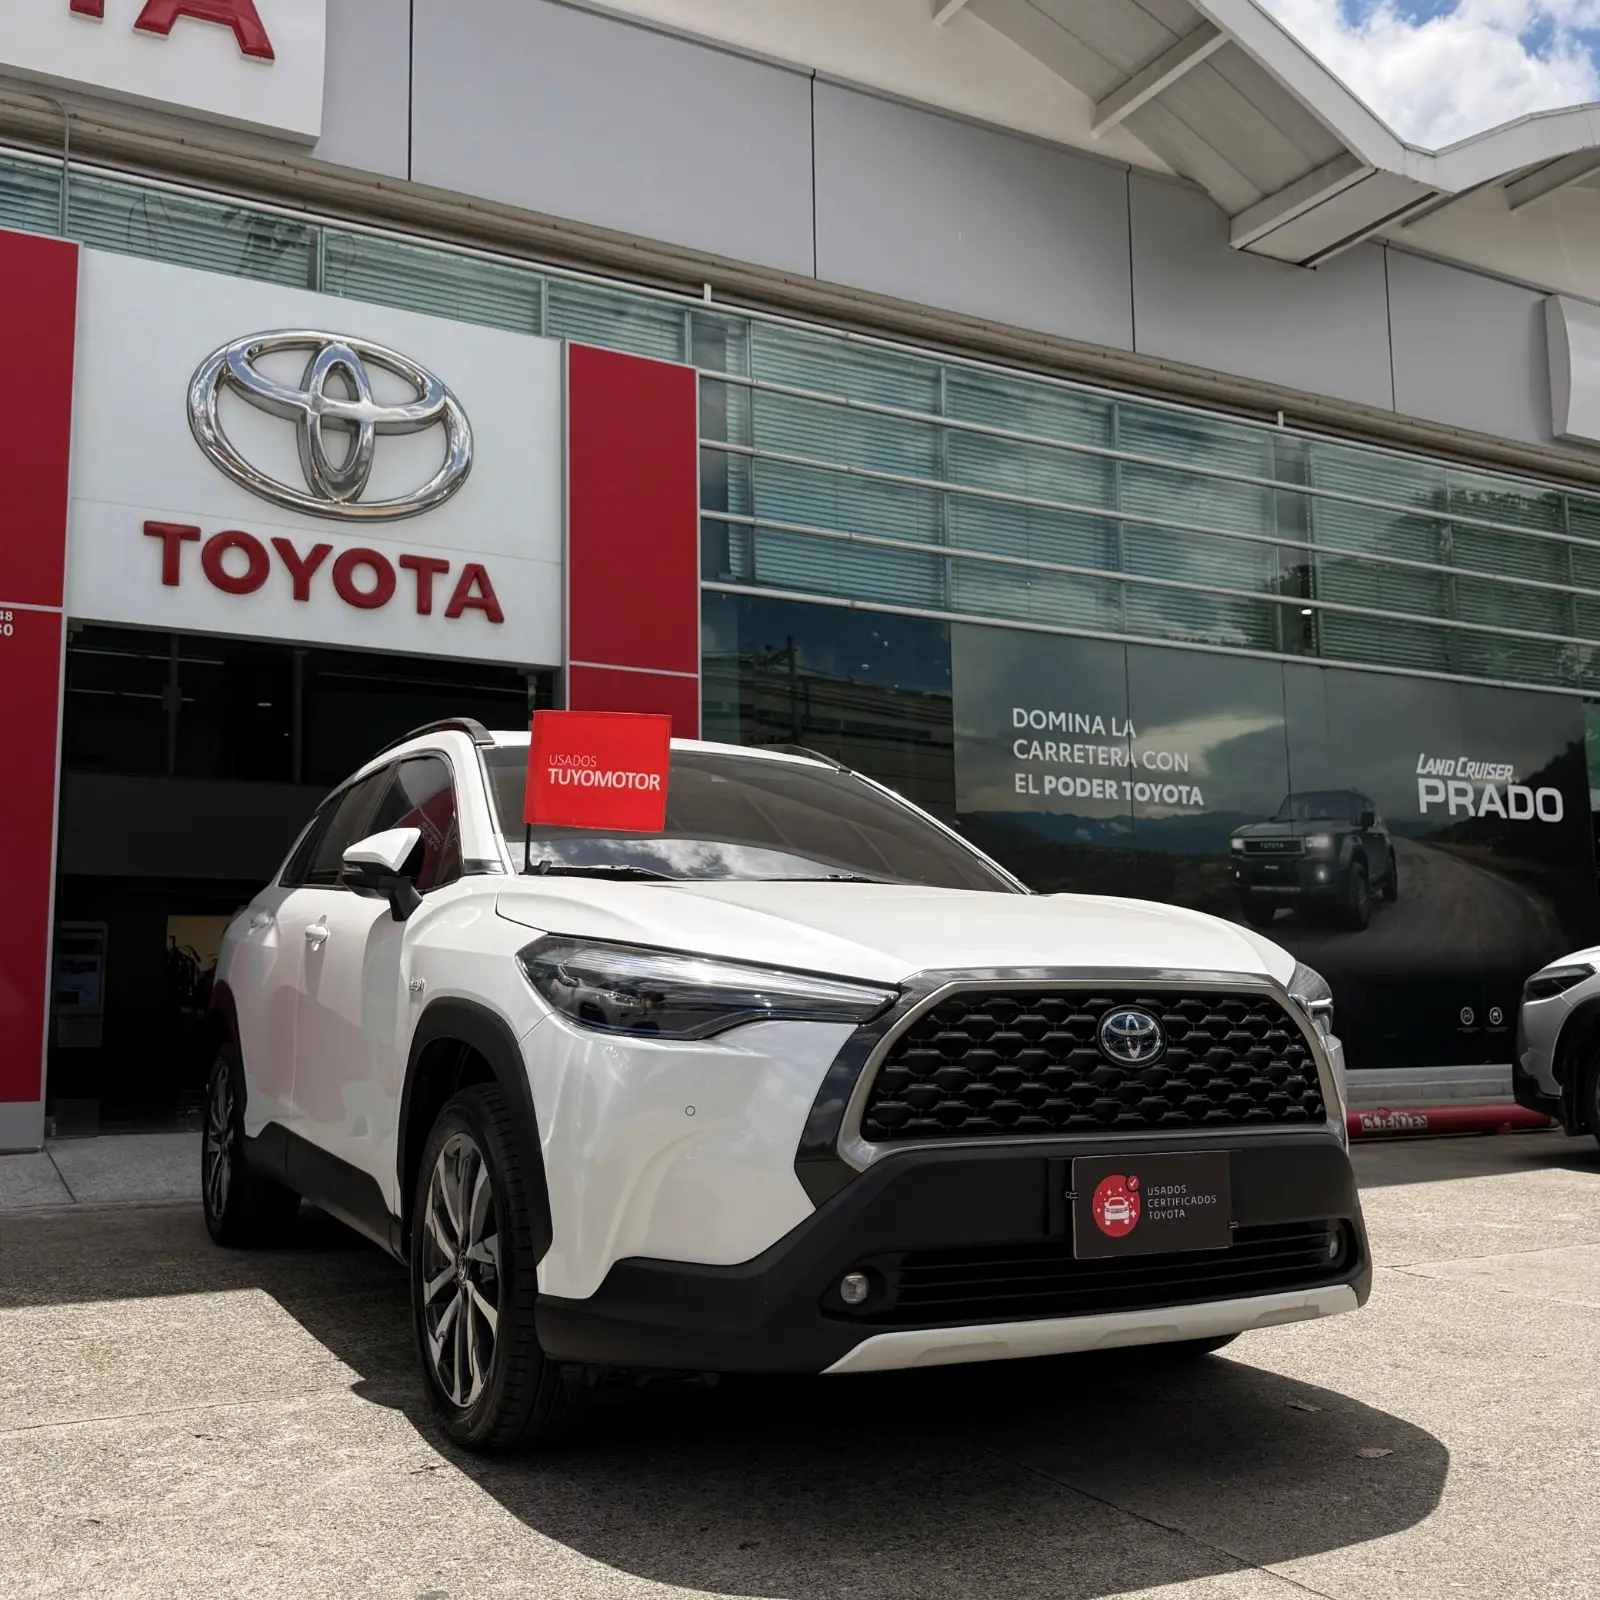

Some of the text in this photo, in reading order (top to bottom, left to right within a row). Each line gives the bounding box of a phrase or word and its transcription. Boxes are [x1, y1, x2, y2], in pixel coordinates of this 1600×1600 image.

[144, 520, 504, 624] TOYOTA
[0, 623, 13, 636] 0
[1012, 707, 1137, 738] DOMINA LA
[549, 754, 597, 768] USADOS
[1013, 739, 1189, 773] CARRETERA CON
[1416, 753, 1514, 783] LAND CRUISER
[548, 768, 661, 790] TUYOMOTOR
[1014, 773, 1204, 806] EL PODER TOYOTA
[1417, 777, 1564, 823] PRADO
[1147, 1184, 1187, 1196] USADOS
[1147, 1194, 1217, 1208] CERTIFICADOS
[1148, 1209, 1186, 1220] TOYOTA
